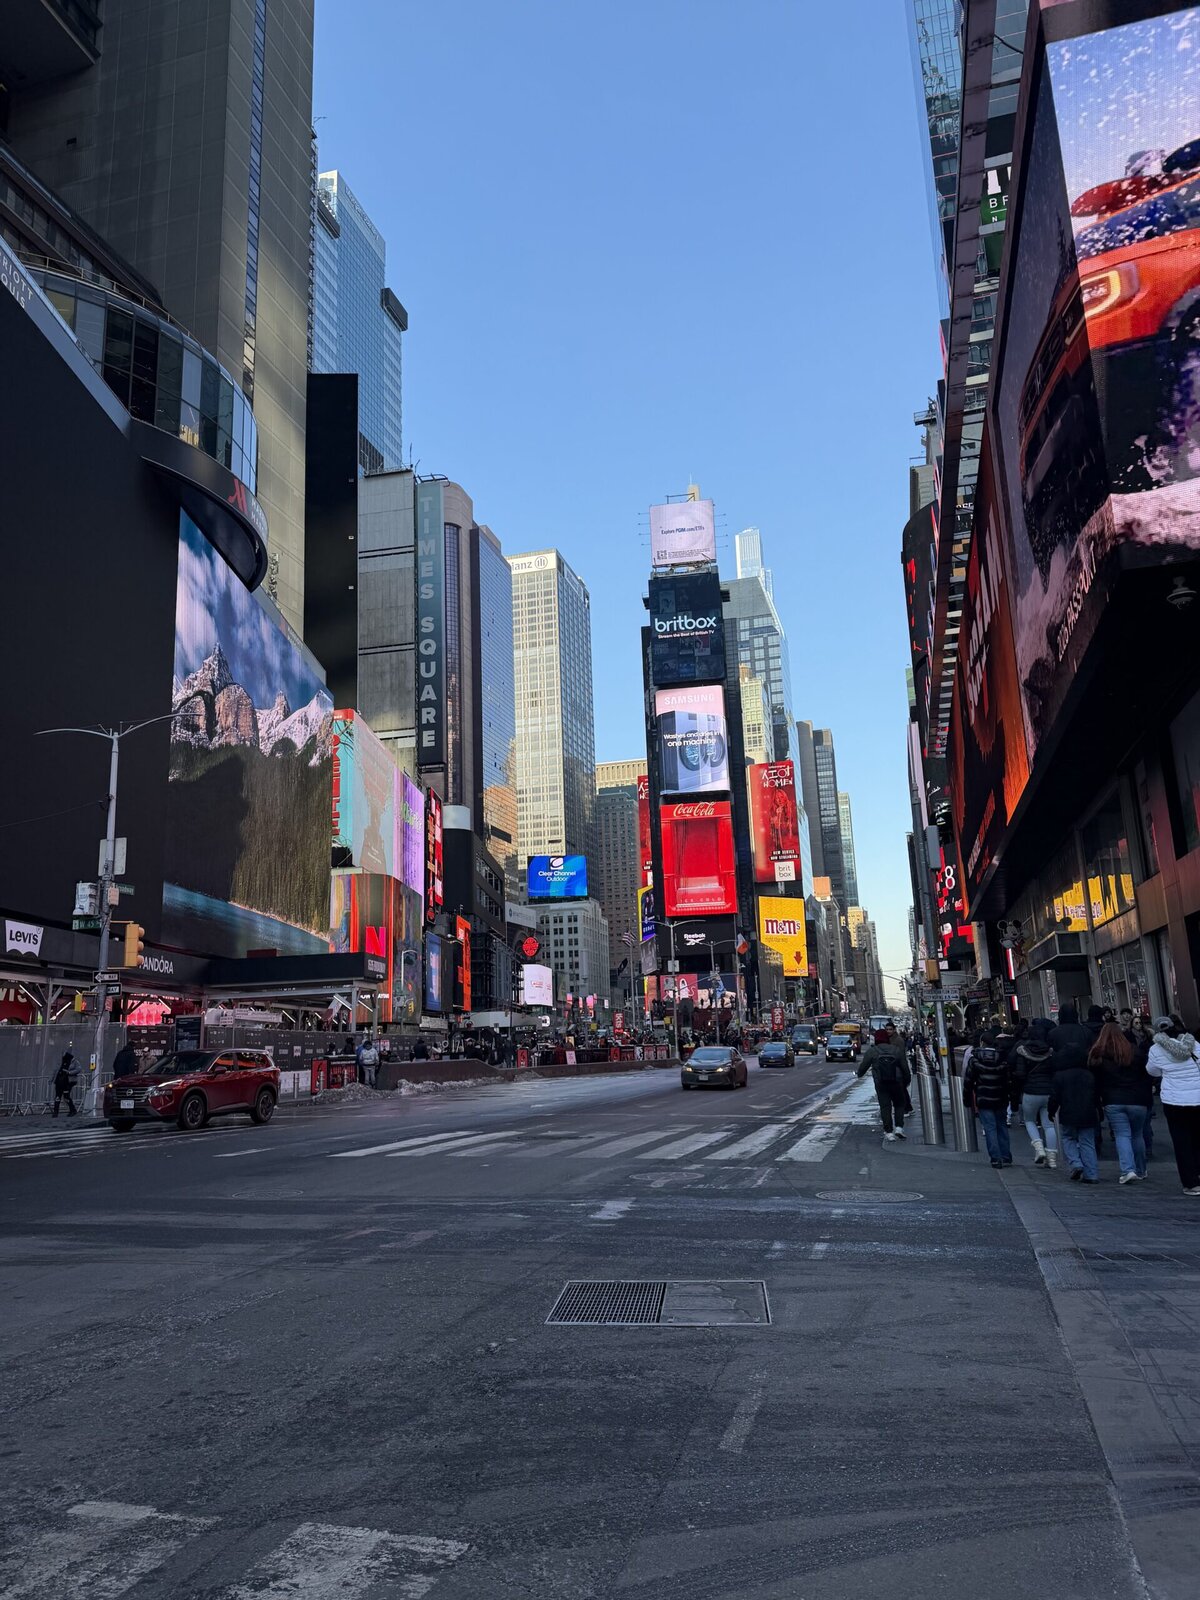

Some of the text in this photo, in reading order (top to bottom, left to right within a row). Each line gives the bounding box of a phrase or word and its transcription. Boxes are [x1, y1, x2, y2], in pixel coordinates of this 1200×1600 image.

[418, 496, 437, 600] TIMES
[654, 615, 717, 633] britbox
[418, 616, 437, 747] SQUARE
[664, 693, 714, 705] SAMSUNG
[683, 738, 716, 746] machine
[778, 863, 791, 871] brit
[779, 870, 792, 878] box
[365, 925, 386, 958] N
